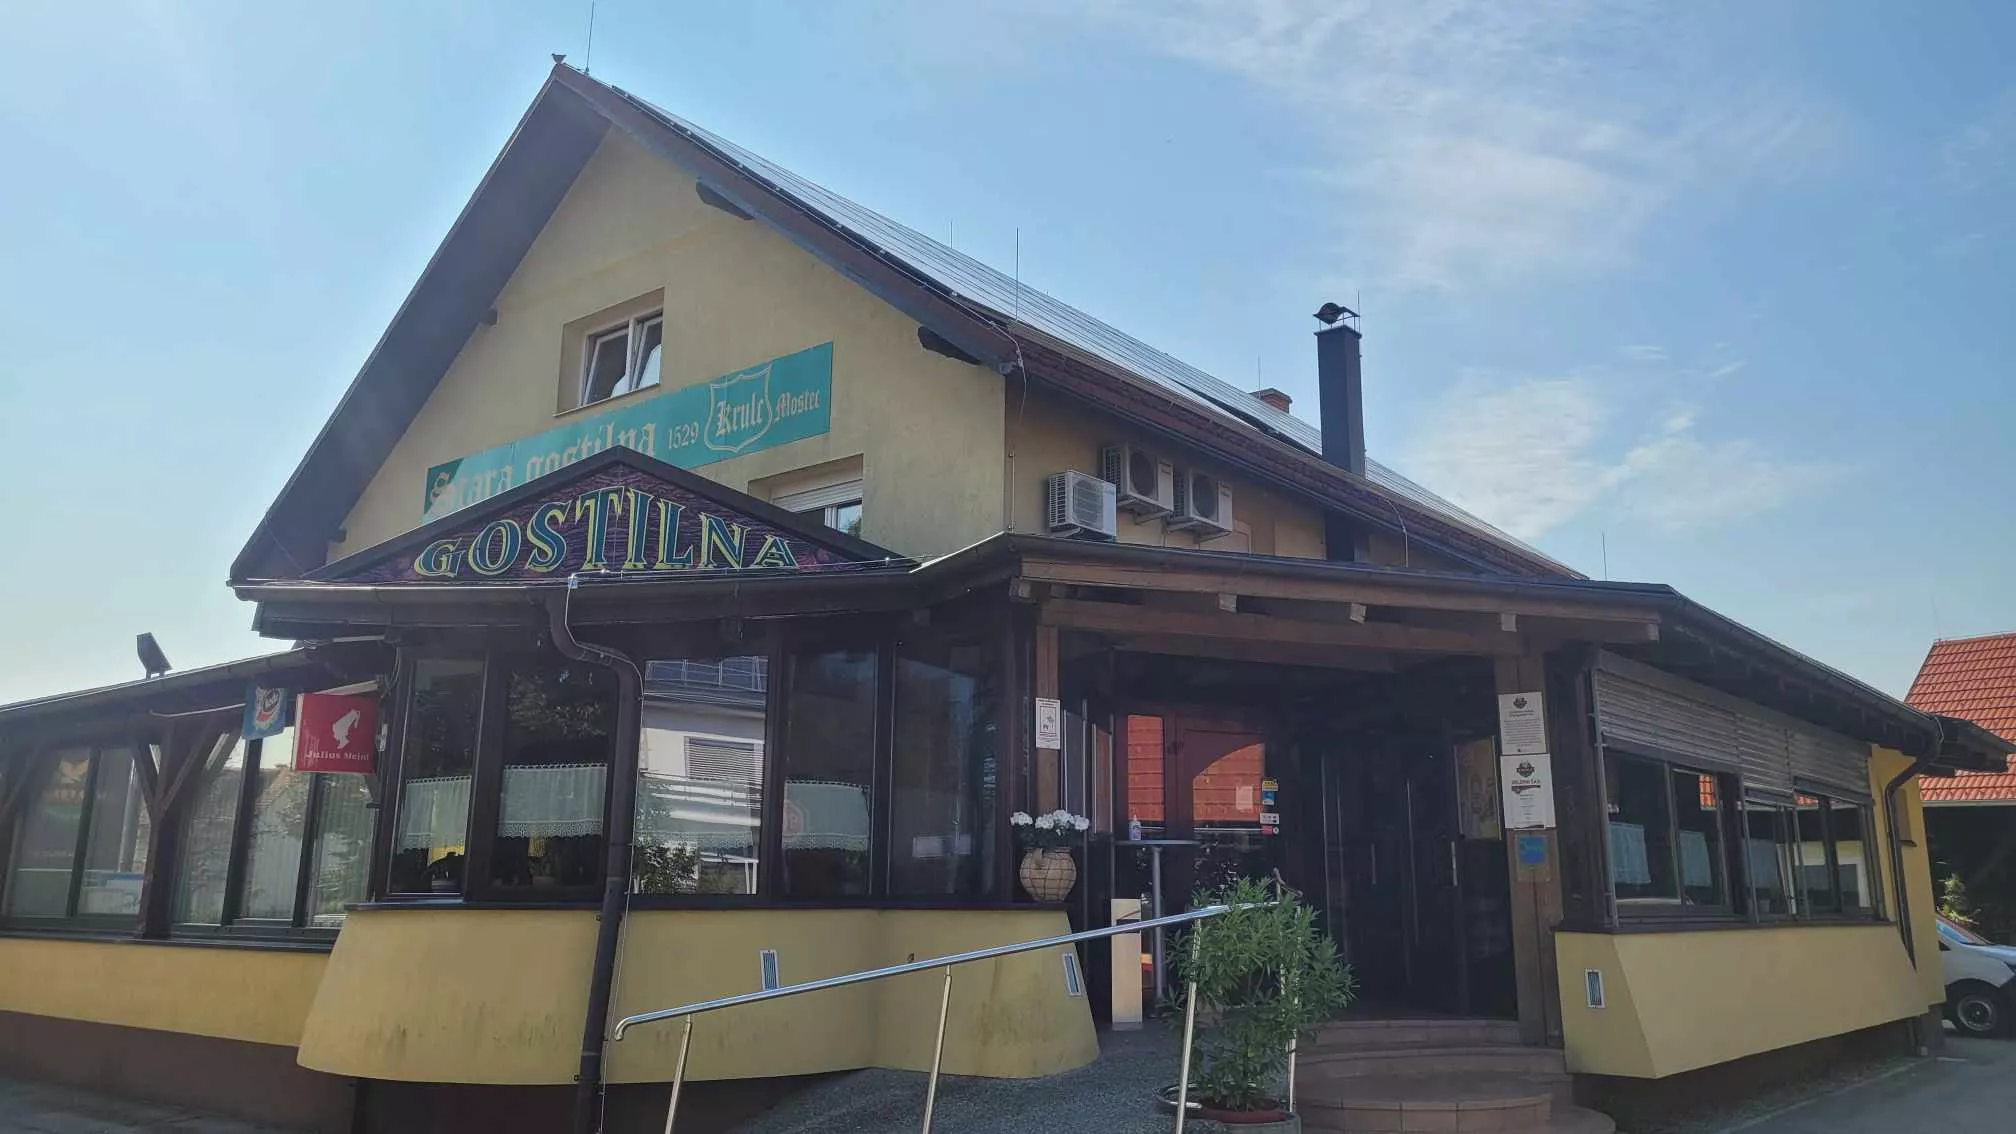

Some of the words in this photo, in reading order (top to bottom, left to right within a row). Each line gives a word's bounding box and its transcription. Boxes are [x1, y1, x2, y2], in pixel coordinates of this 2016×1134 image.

[667, 421, 700, 450] 1529
[414, 485, 800, 577] GOSTILNA
[304, 750, 341, 760] Julius
[344, 751, 369, 761] Meinl
